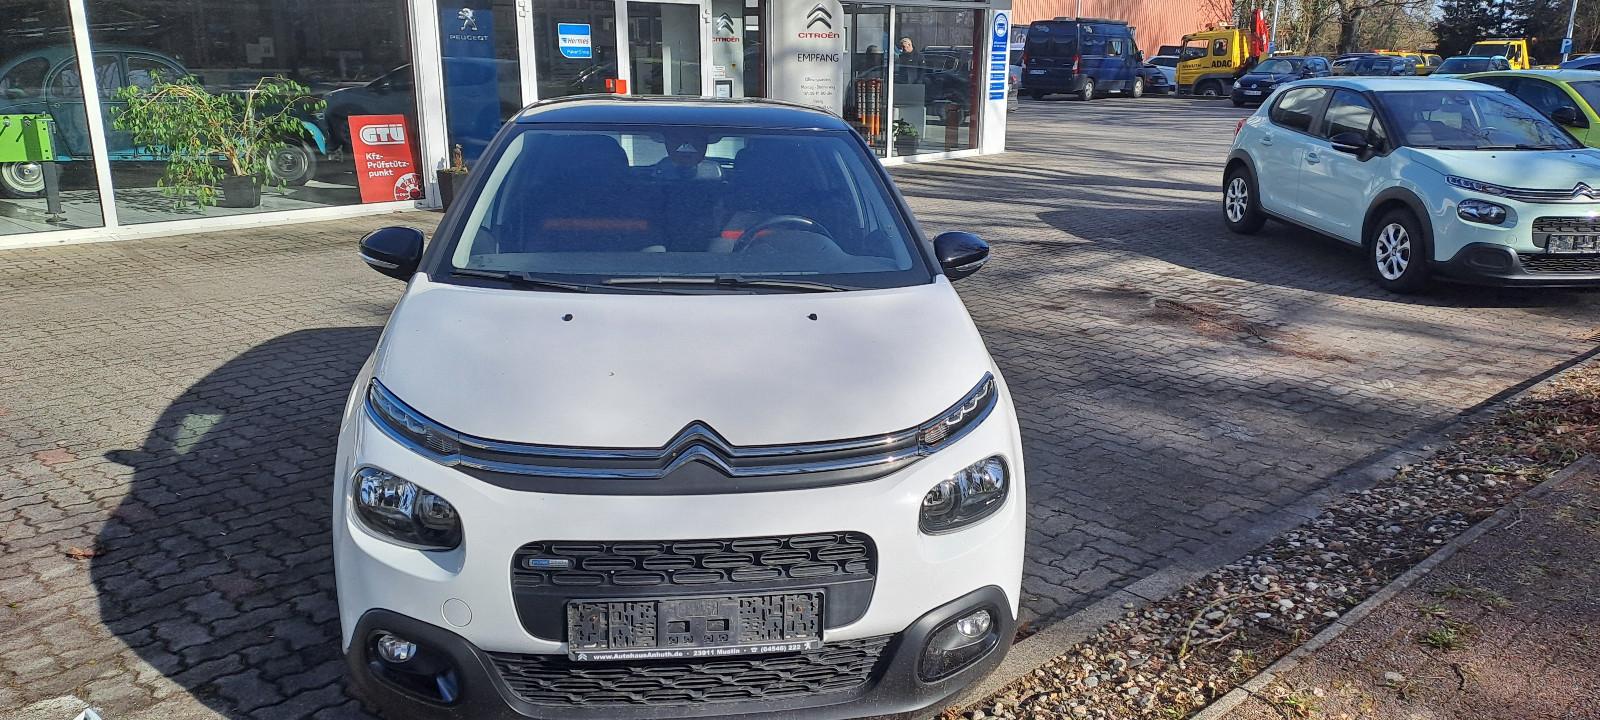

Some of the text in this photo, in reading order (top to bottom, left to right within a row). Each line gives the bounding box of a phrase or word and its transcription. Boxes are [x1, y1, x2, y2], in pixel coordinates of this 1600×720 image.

[1561, 38, 1572, 53] P
[797, 53, 839, 62] EMPFANG
[1211, 60, 1232, 68] ADAC
[367, 160, 409, 169] Prüfstütz-
[368, 169, 394, 178] punkt
[593, 651, 683, 661] www.AutohausAnhuth.de
[716, 647, 740, 655] Mustin
